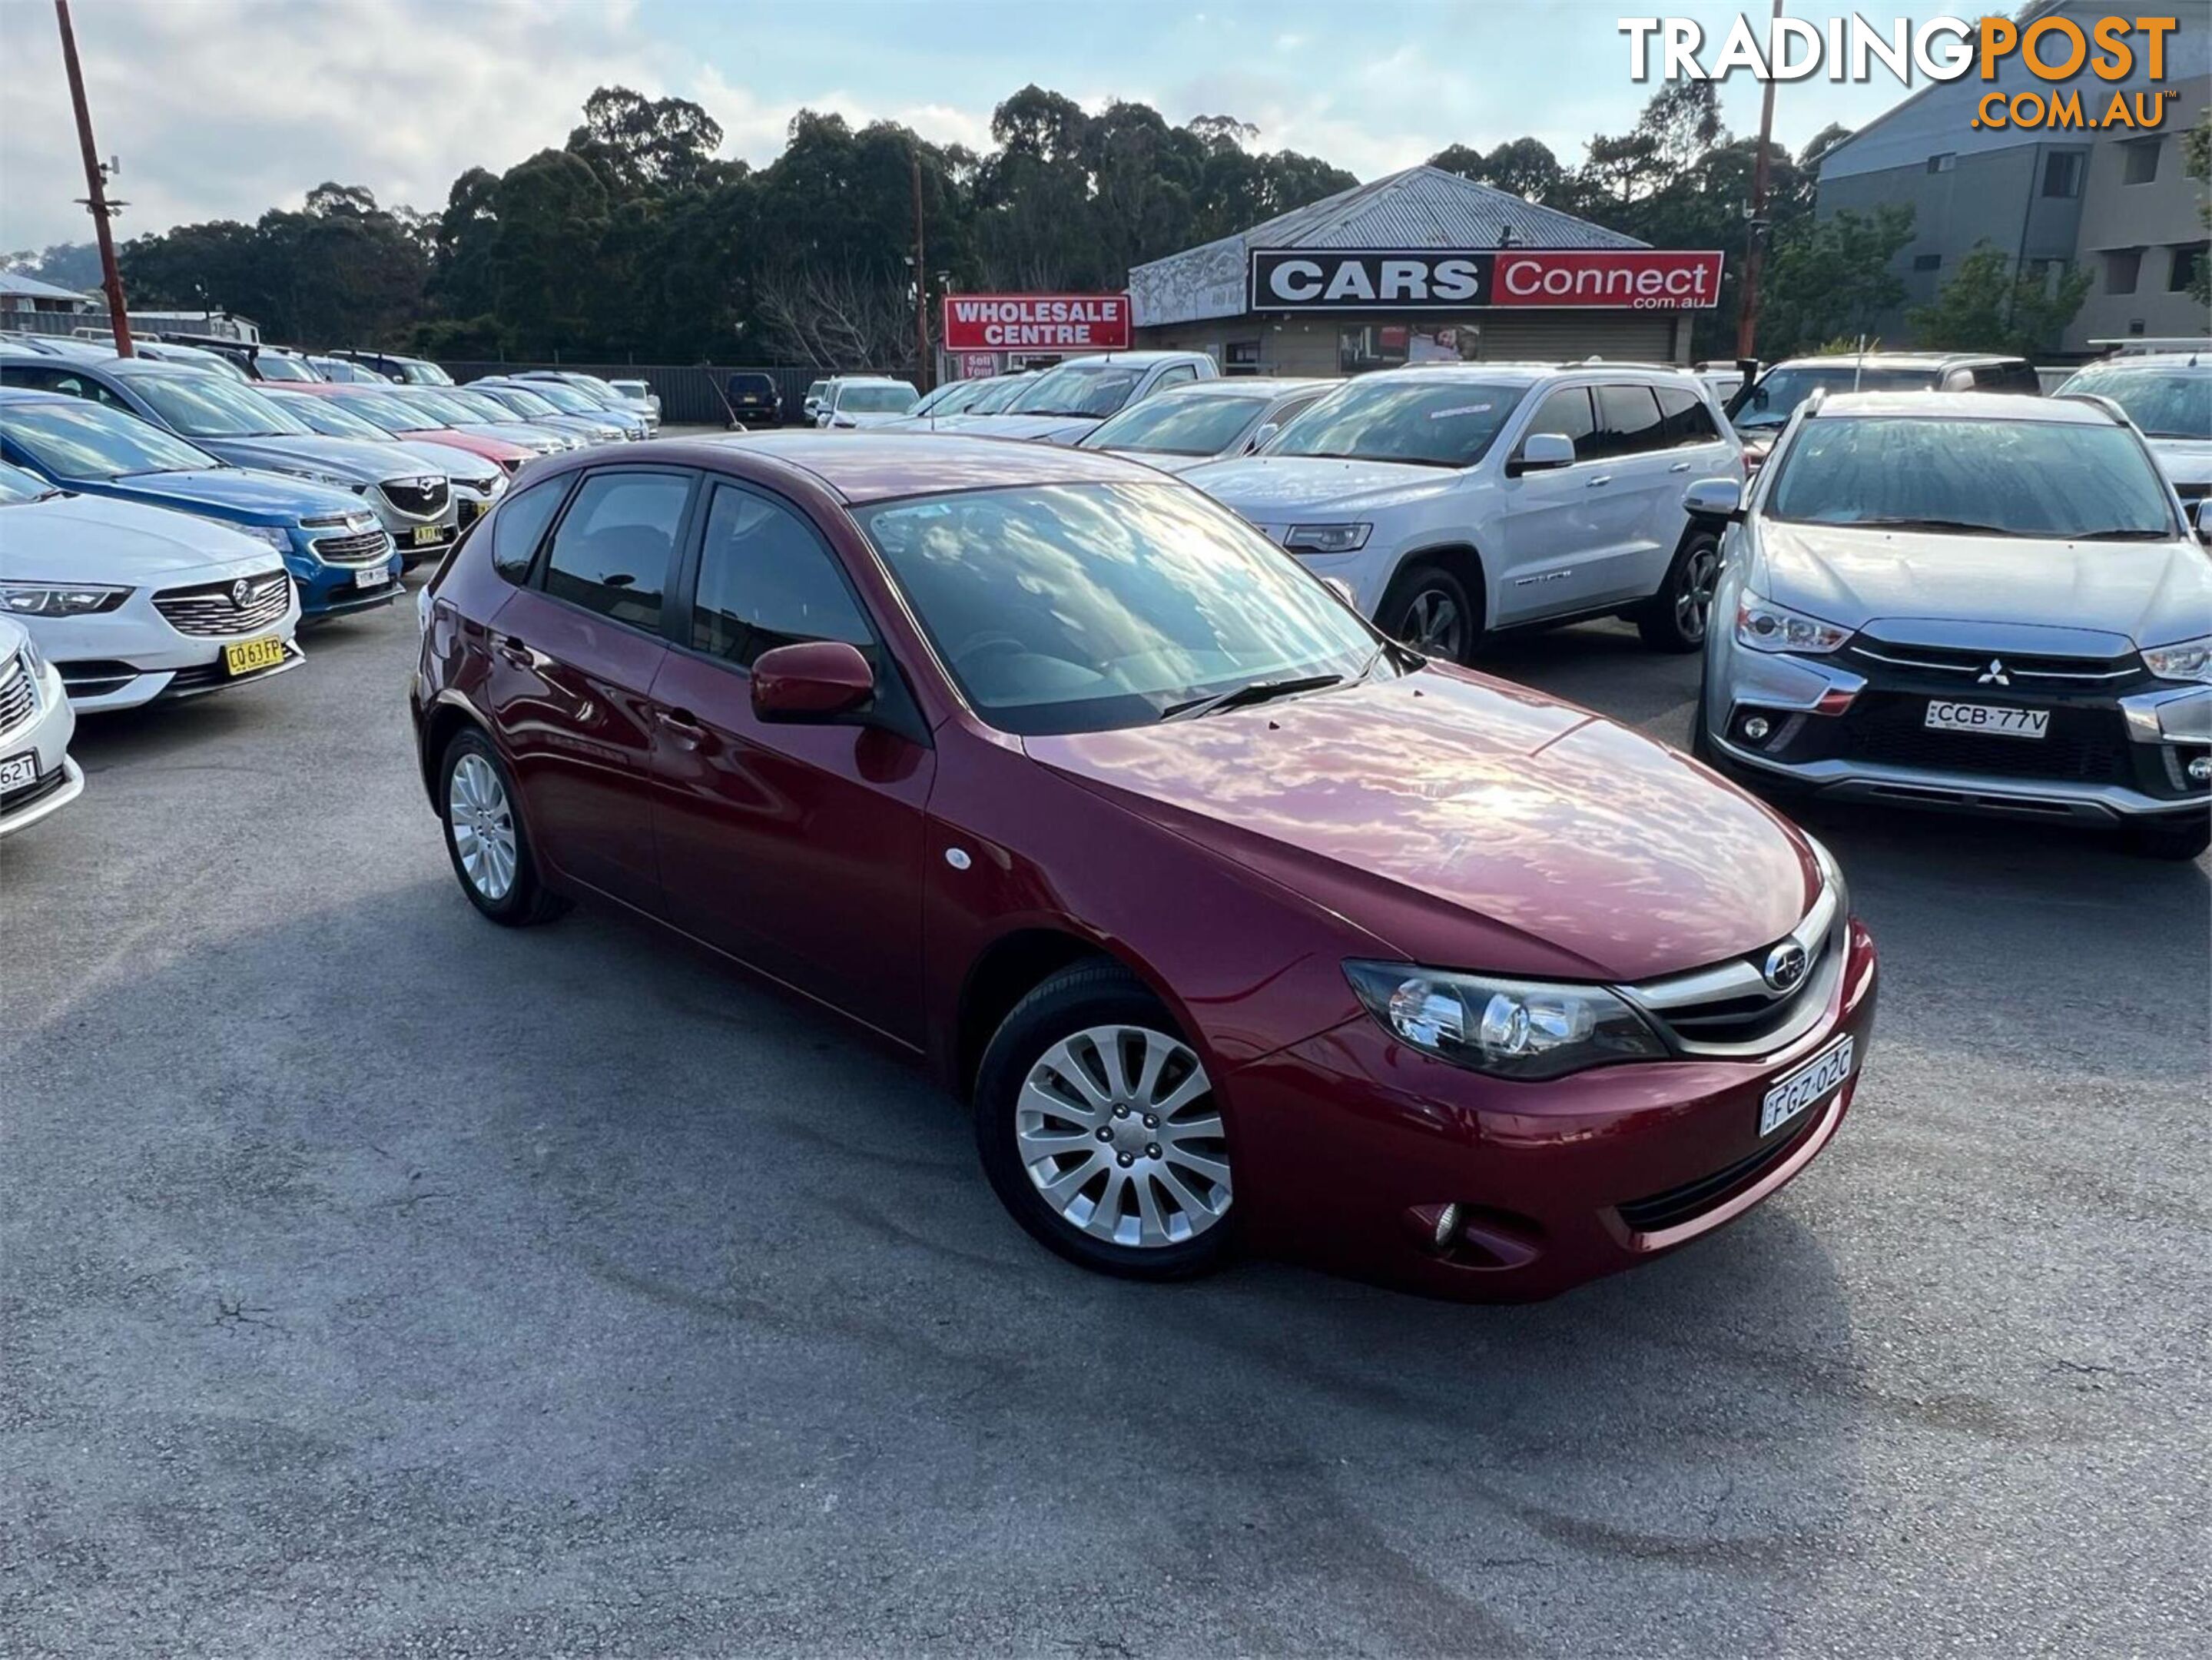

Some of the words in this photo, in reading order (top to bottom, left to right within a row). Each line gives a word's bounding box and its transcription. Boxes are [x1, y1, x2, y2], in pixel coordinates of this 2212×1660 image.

[1270, 260, 1478, 300] CARS
[1505, 261, 1708, 294] Connect
[955, 302, 1117, 323] WHOLESALE
[985, 324, 1090, 344] CENTRE
